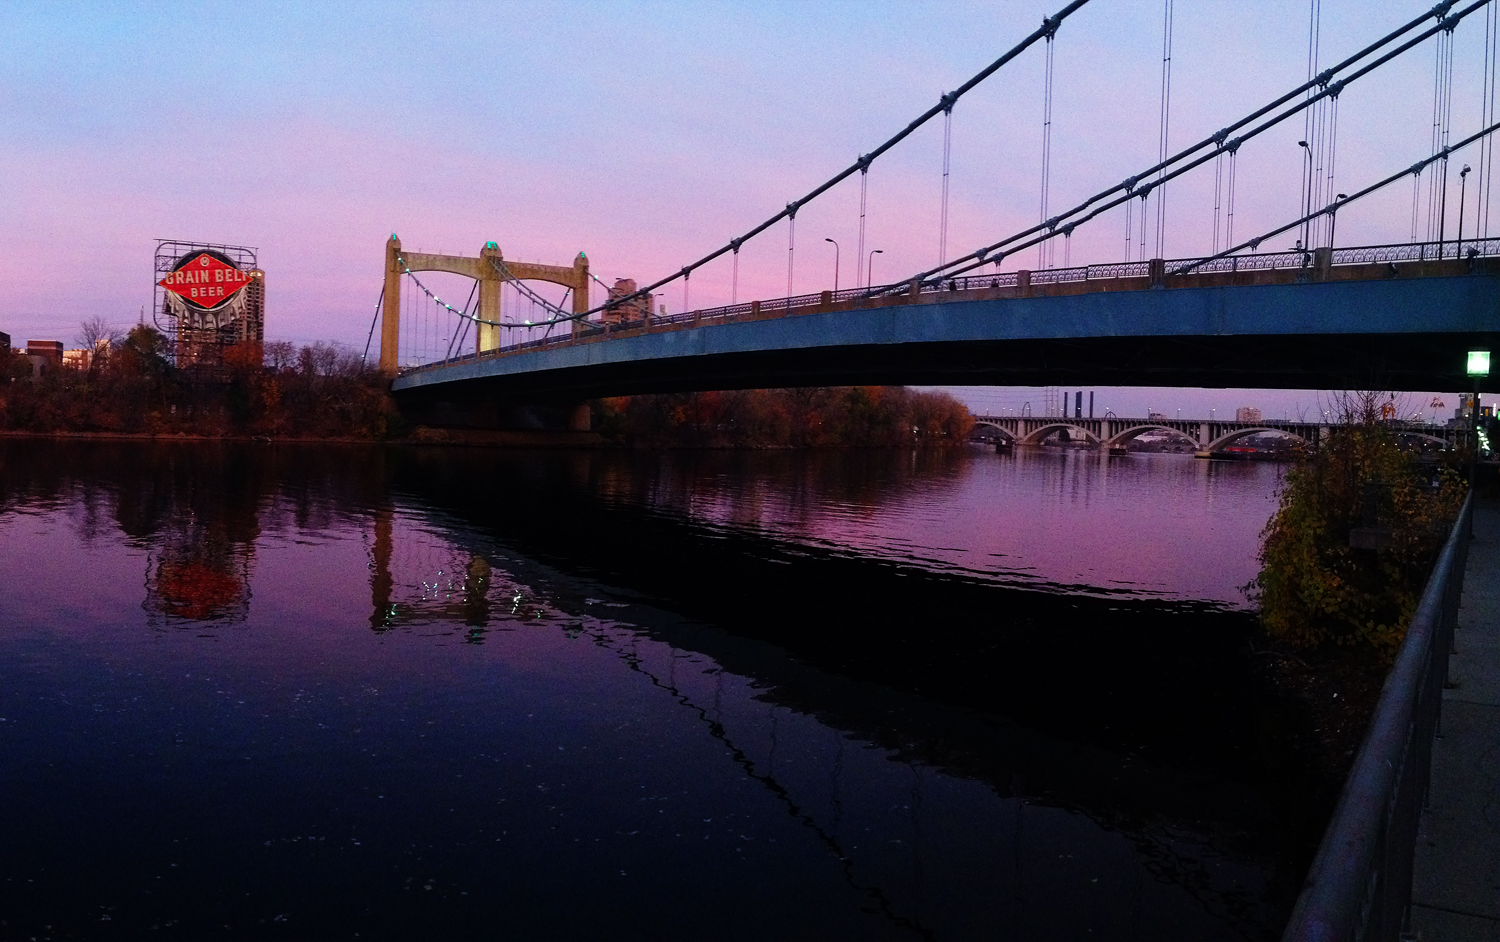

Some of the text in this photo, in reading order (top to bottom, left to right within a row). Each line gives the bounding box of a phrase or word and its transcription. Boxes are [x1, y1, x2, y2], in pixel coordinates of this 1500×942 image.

[166, 269, 246, 284] GRAIN BELT
[191, 287, 224, 297] BEER
